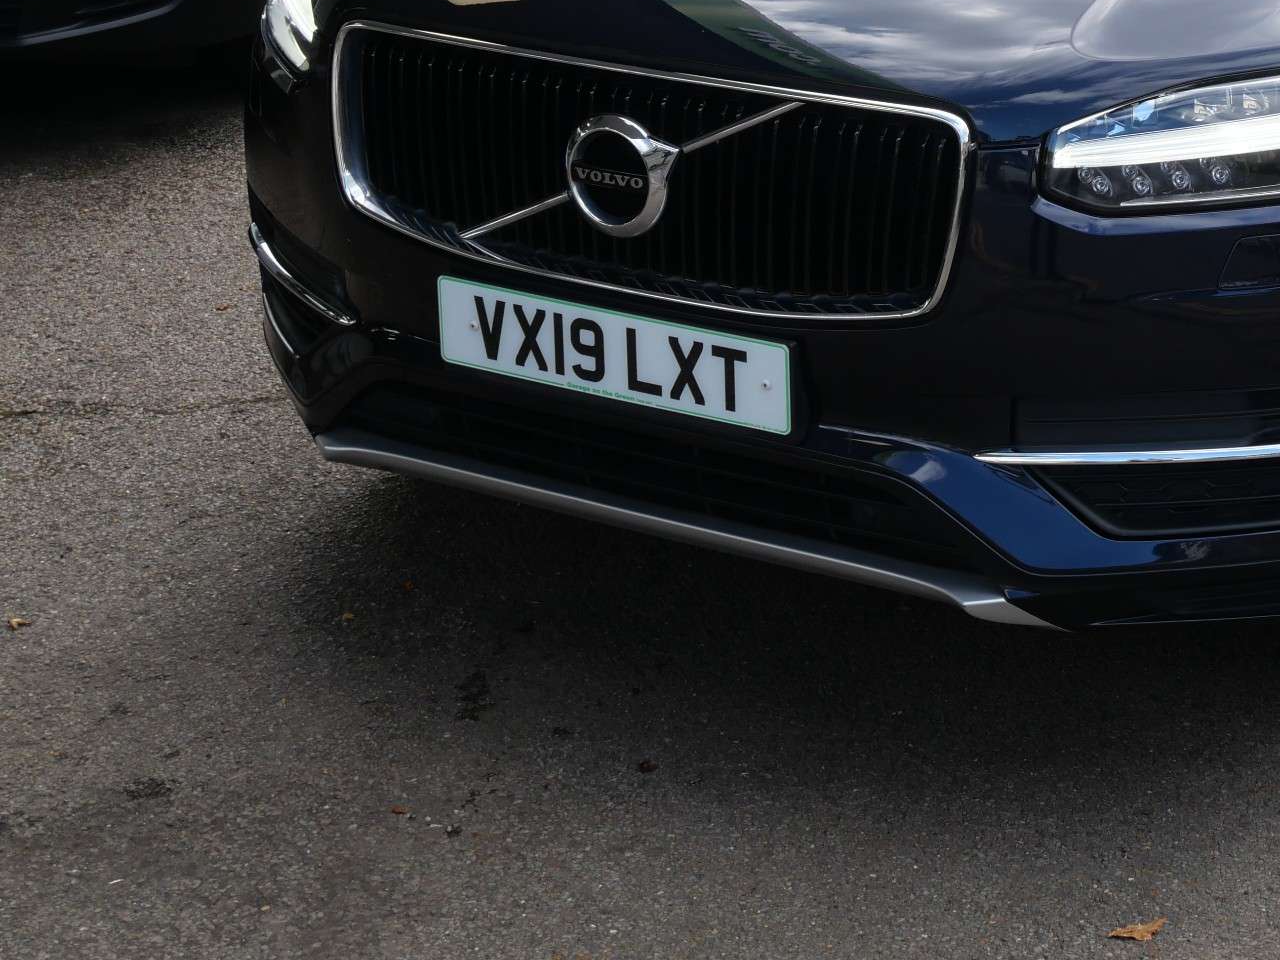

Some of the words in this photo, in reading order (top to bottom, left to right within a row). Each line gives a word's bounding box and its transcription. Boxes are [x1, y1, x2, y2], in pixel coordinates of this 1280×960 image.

[574, 166, 644, 189] VOLVO
[474, 295, 605, 382] VX19
[626, 327, 747, 412] LXT
